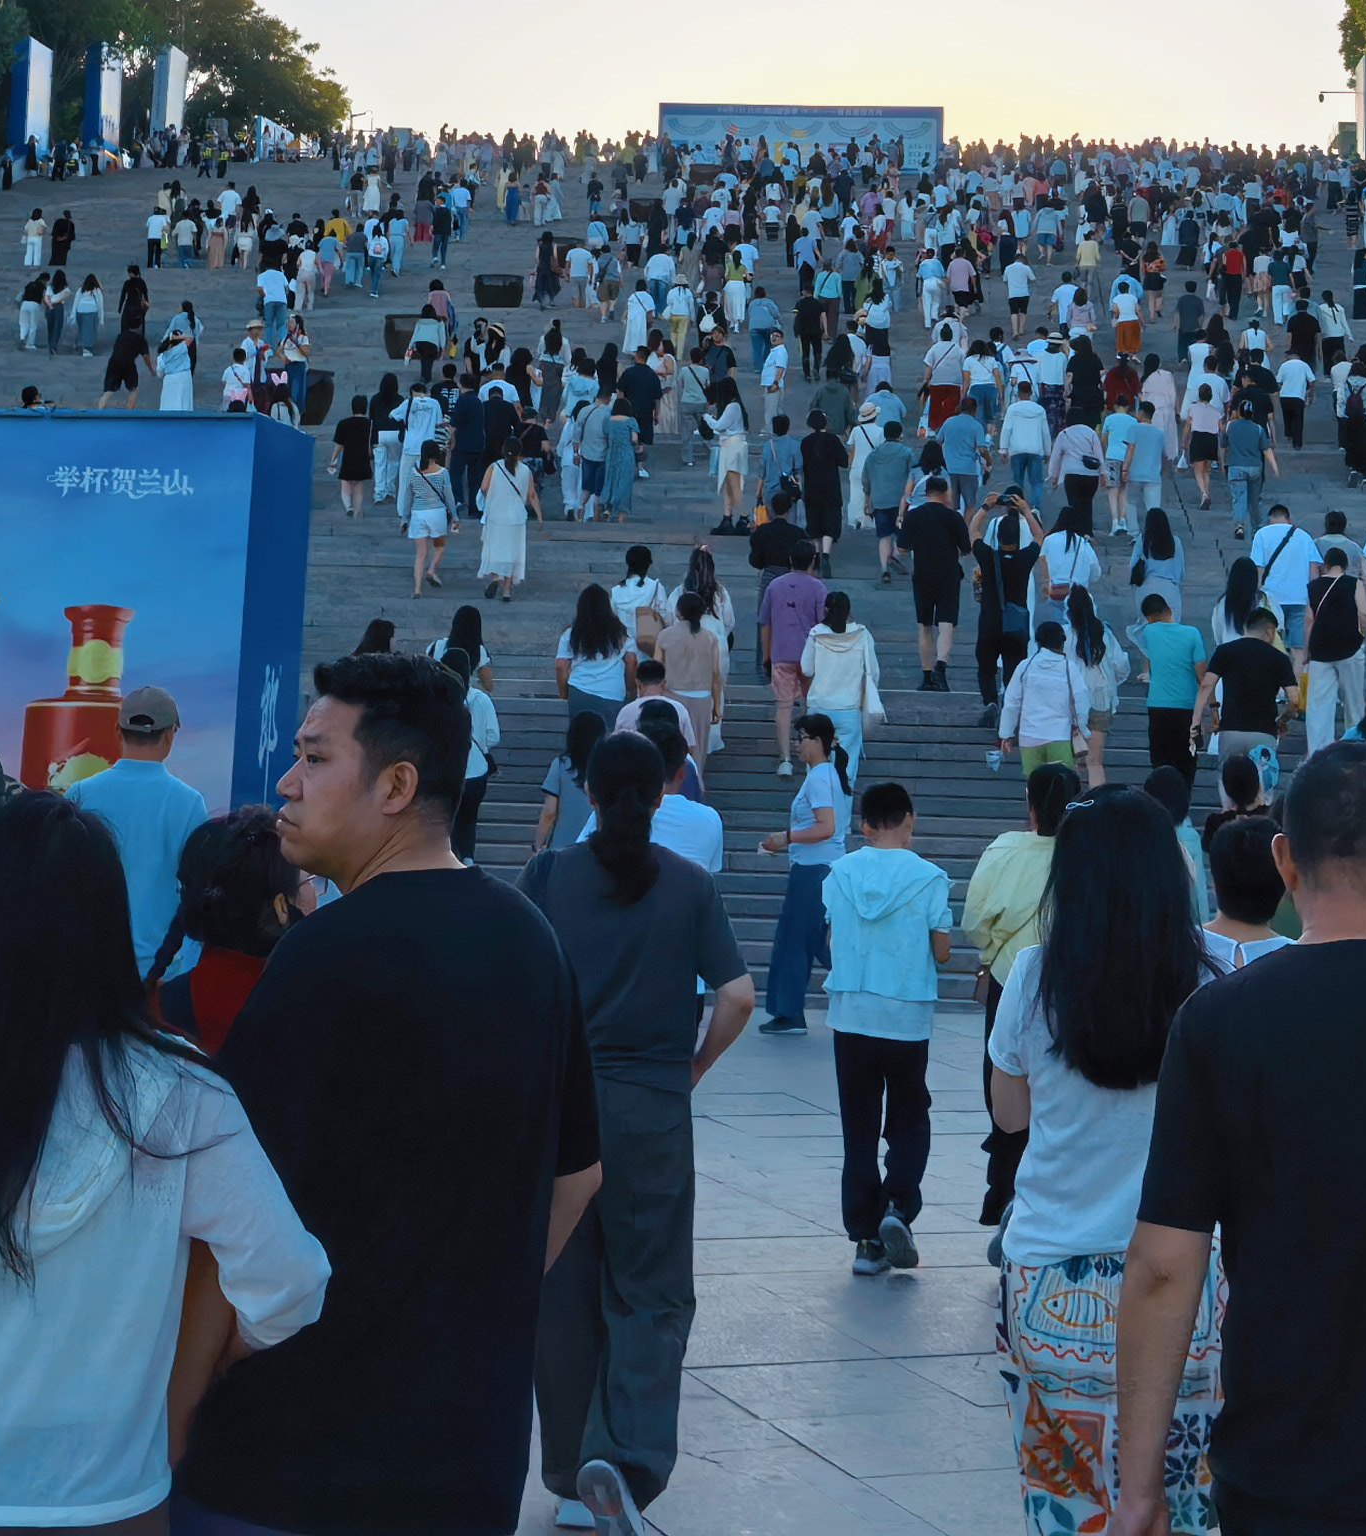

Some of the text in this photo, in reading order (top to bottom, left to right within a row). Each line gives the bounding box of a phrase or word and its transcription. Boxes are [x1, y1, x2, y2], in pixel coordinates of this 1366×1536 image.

[46, 465, 195, 500] 举杯贺兰山
